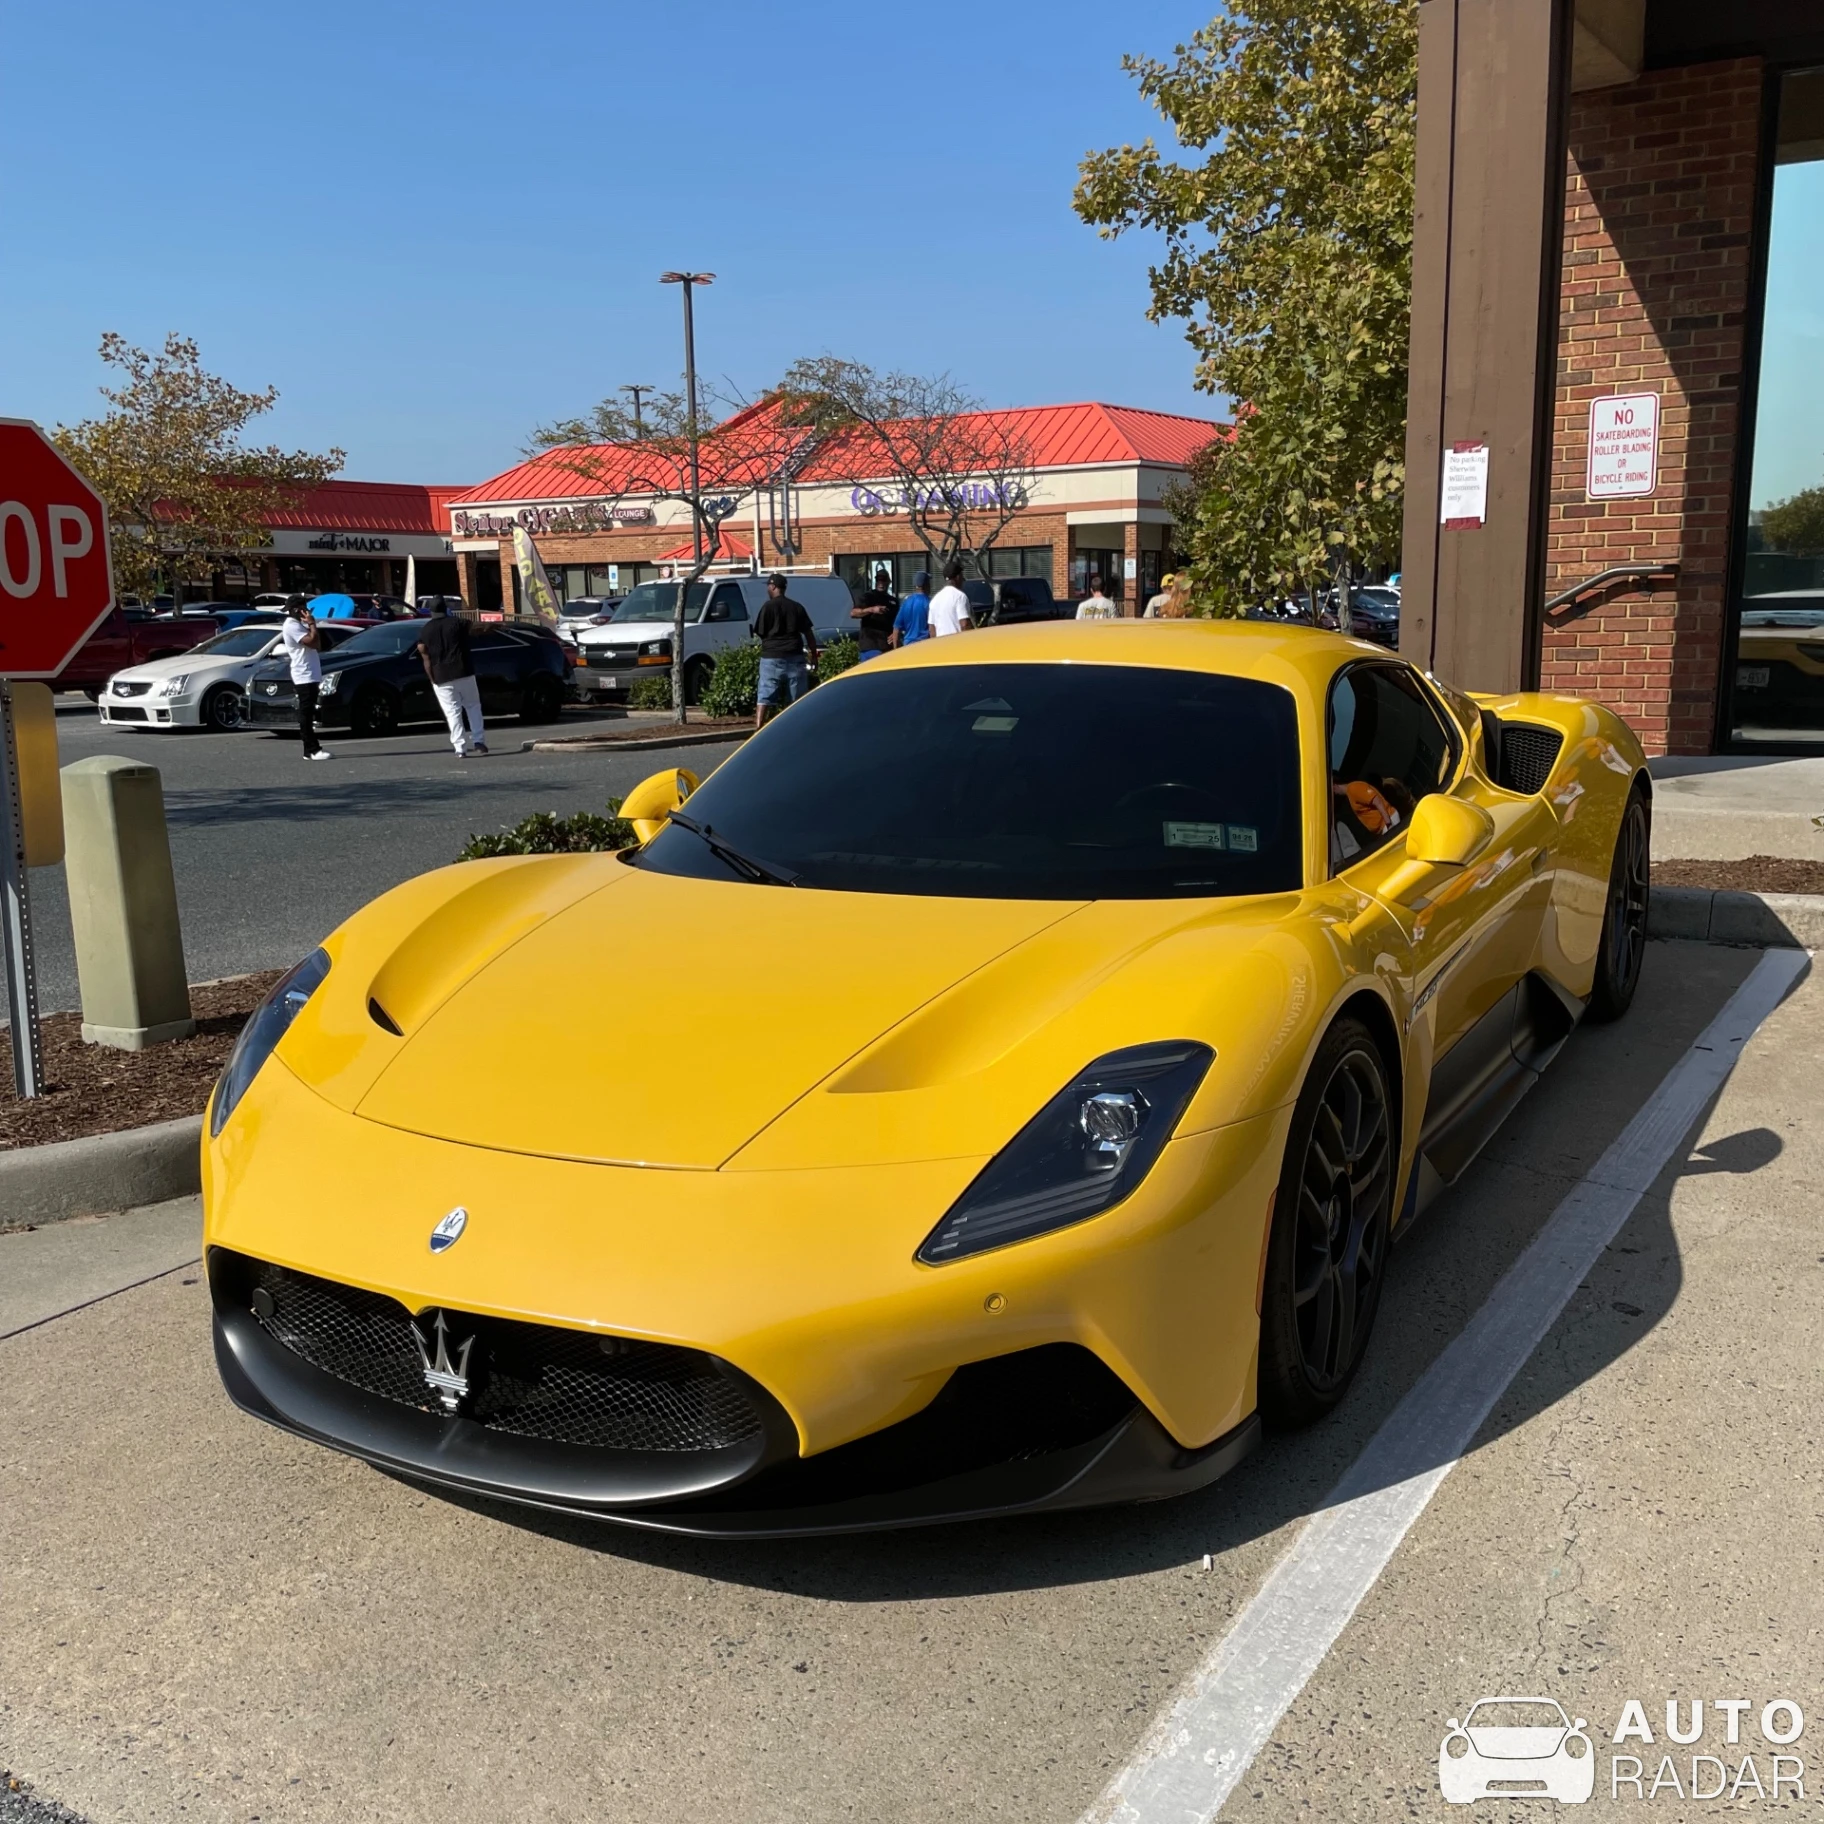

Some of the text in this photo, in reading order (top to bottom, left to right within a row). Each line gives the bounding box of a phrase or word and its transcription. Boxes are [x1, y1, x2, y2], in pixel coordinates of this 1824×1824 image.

[1614, 408, 1634, 425] NO
[1595, 427, 1652, 441] SKATEBOARDING
[1594, 442, 1652, 456] ROLLER BLADING
[1461, 456, 1486, 464] parking
[1617, 458, 1627, 468] OR
[1594, 471, 1648, 484] BICYCLE RIDING
[1448, 494, 1461, 502] only
[614, 509, 645, 519] LOUNGE
[346, 536, 390, 552] MAJOR
[1208, 835, 1220, 843] 25
